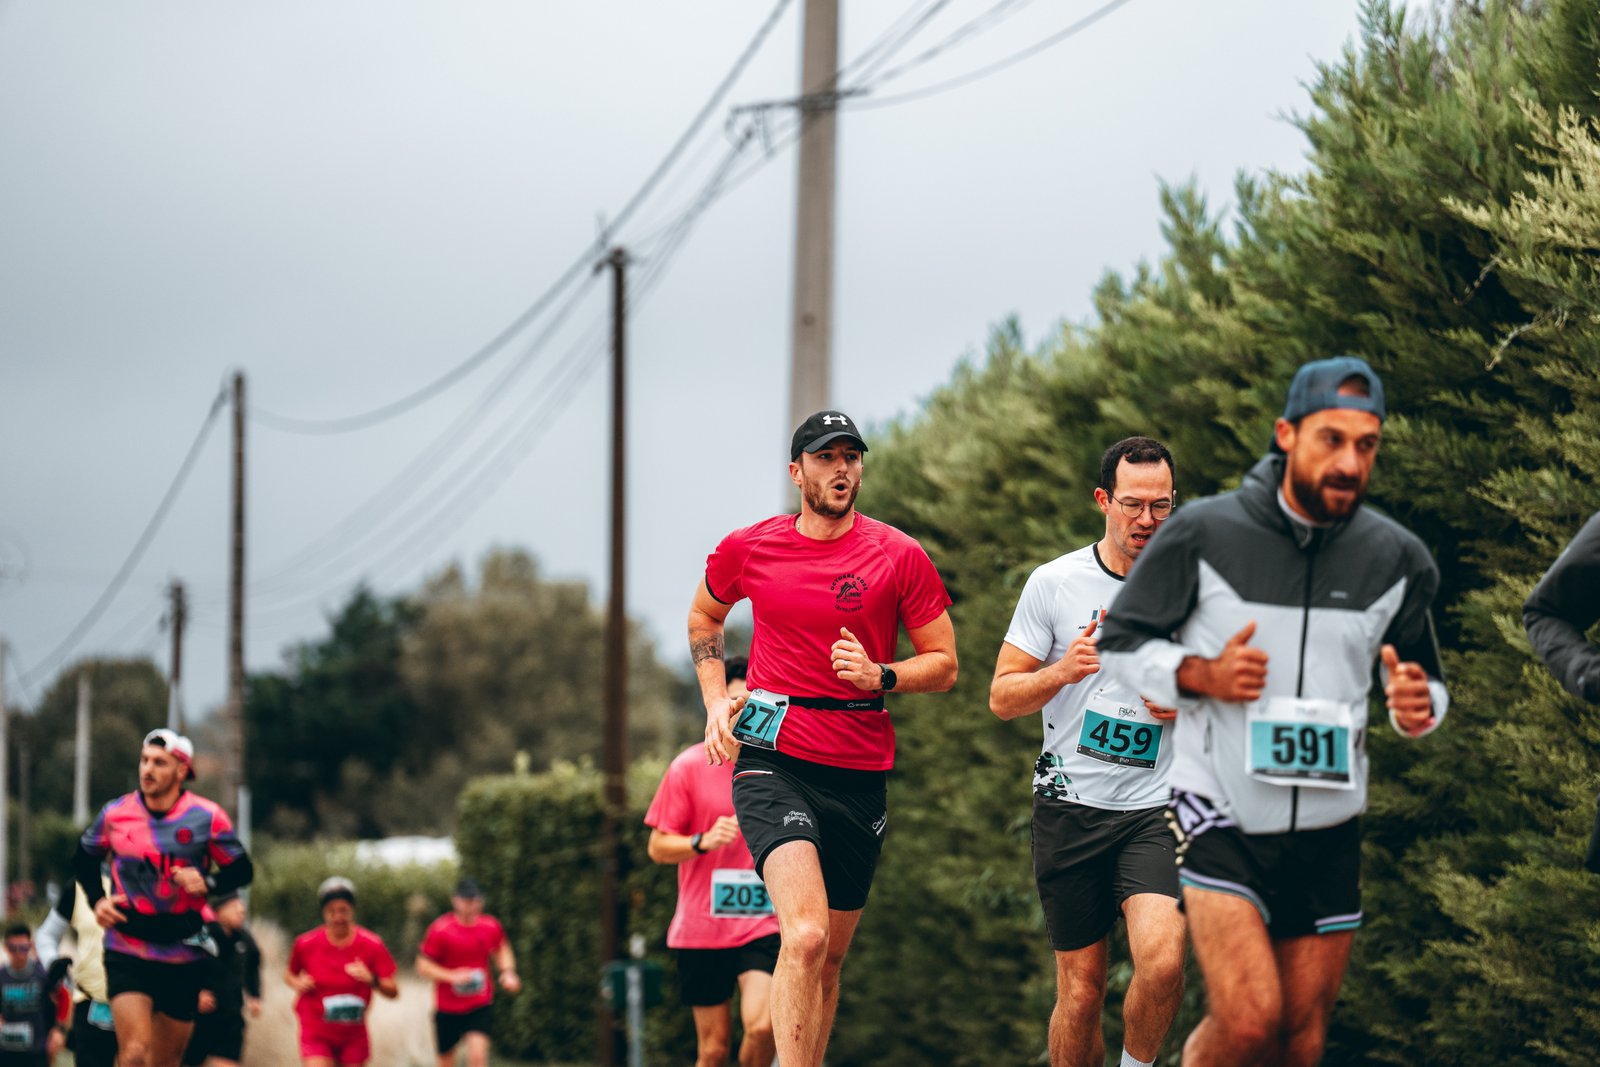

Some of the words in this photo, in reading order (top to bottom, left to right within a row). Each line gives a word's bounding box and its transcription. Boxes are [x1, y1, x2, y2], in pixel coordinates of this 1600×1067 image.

[736, 702, 775, 734] 27
[1089, 719, 1152, 755] 459
[1272, 725, 1335, 768] 591
[721, 884, 767, 907] 203
